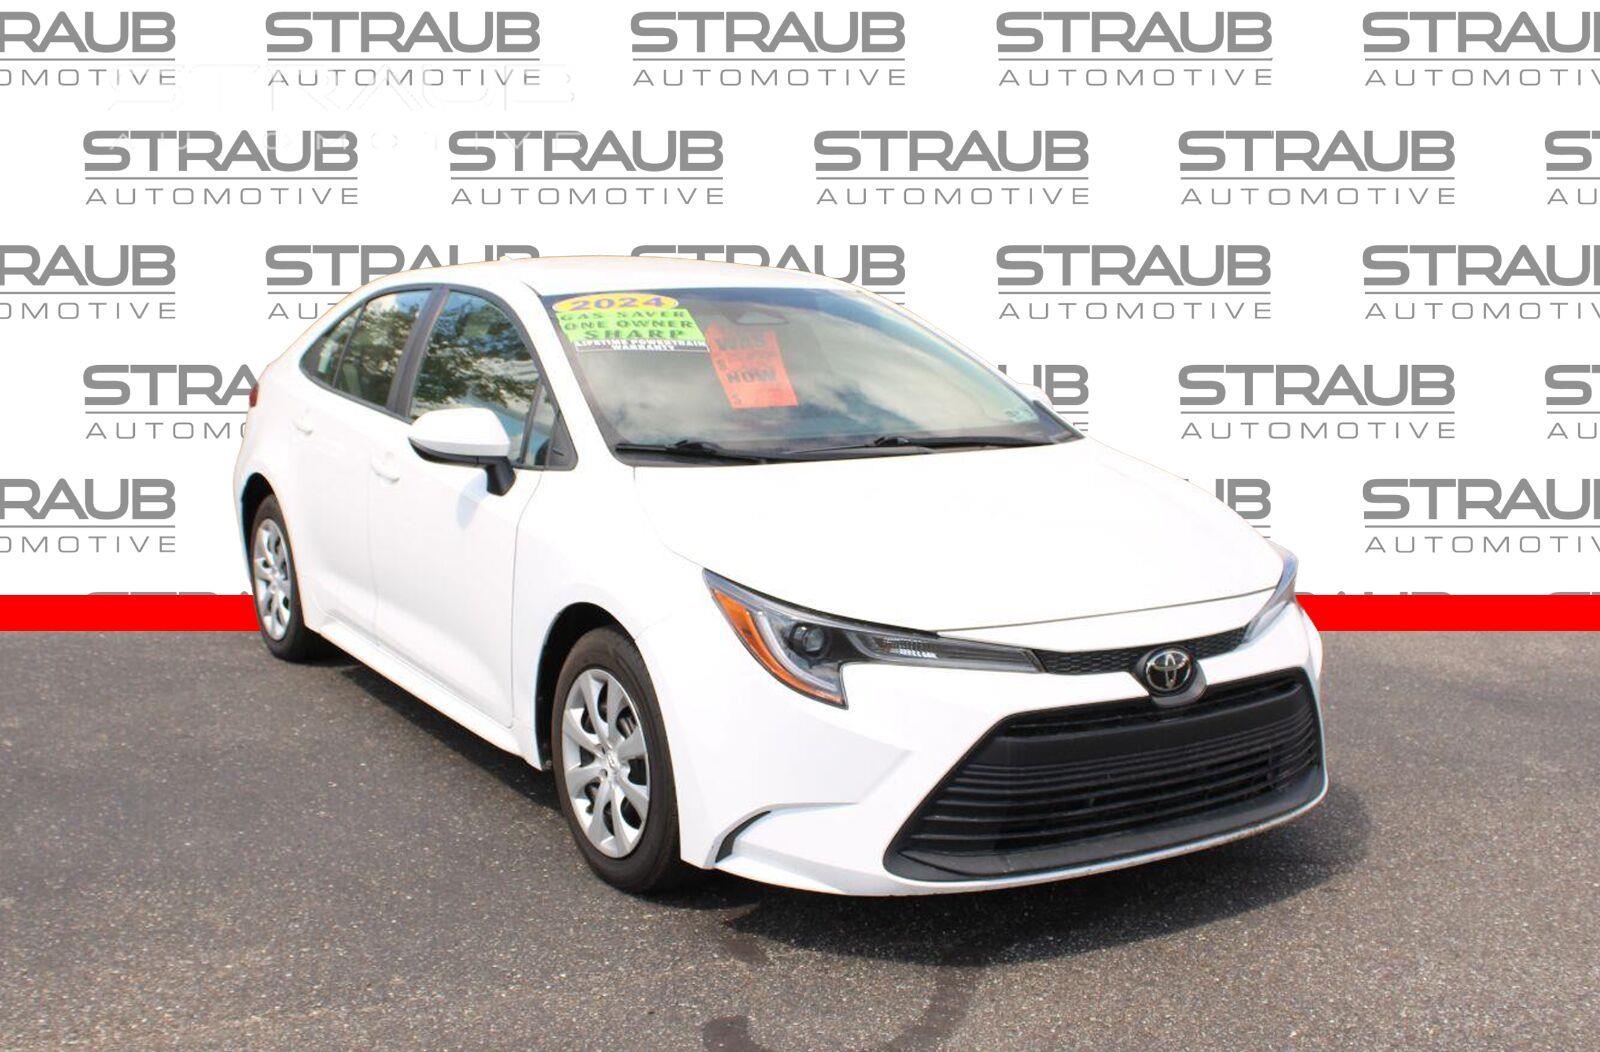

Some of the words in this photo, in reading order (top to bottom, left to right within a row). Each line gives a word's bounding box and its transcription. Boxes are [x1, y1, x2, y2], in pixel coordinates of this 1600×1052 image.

[569, 296, 663, 311] 2024
[560, 313, 604, 321] GAS
[564, 321, 607, 331] ONE
[616, 320, 693, 328] OWNER
[585, 329, 685, 340] SHARP
[726, 369, 776, 384] NOW
